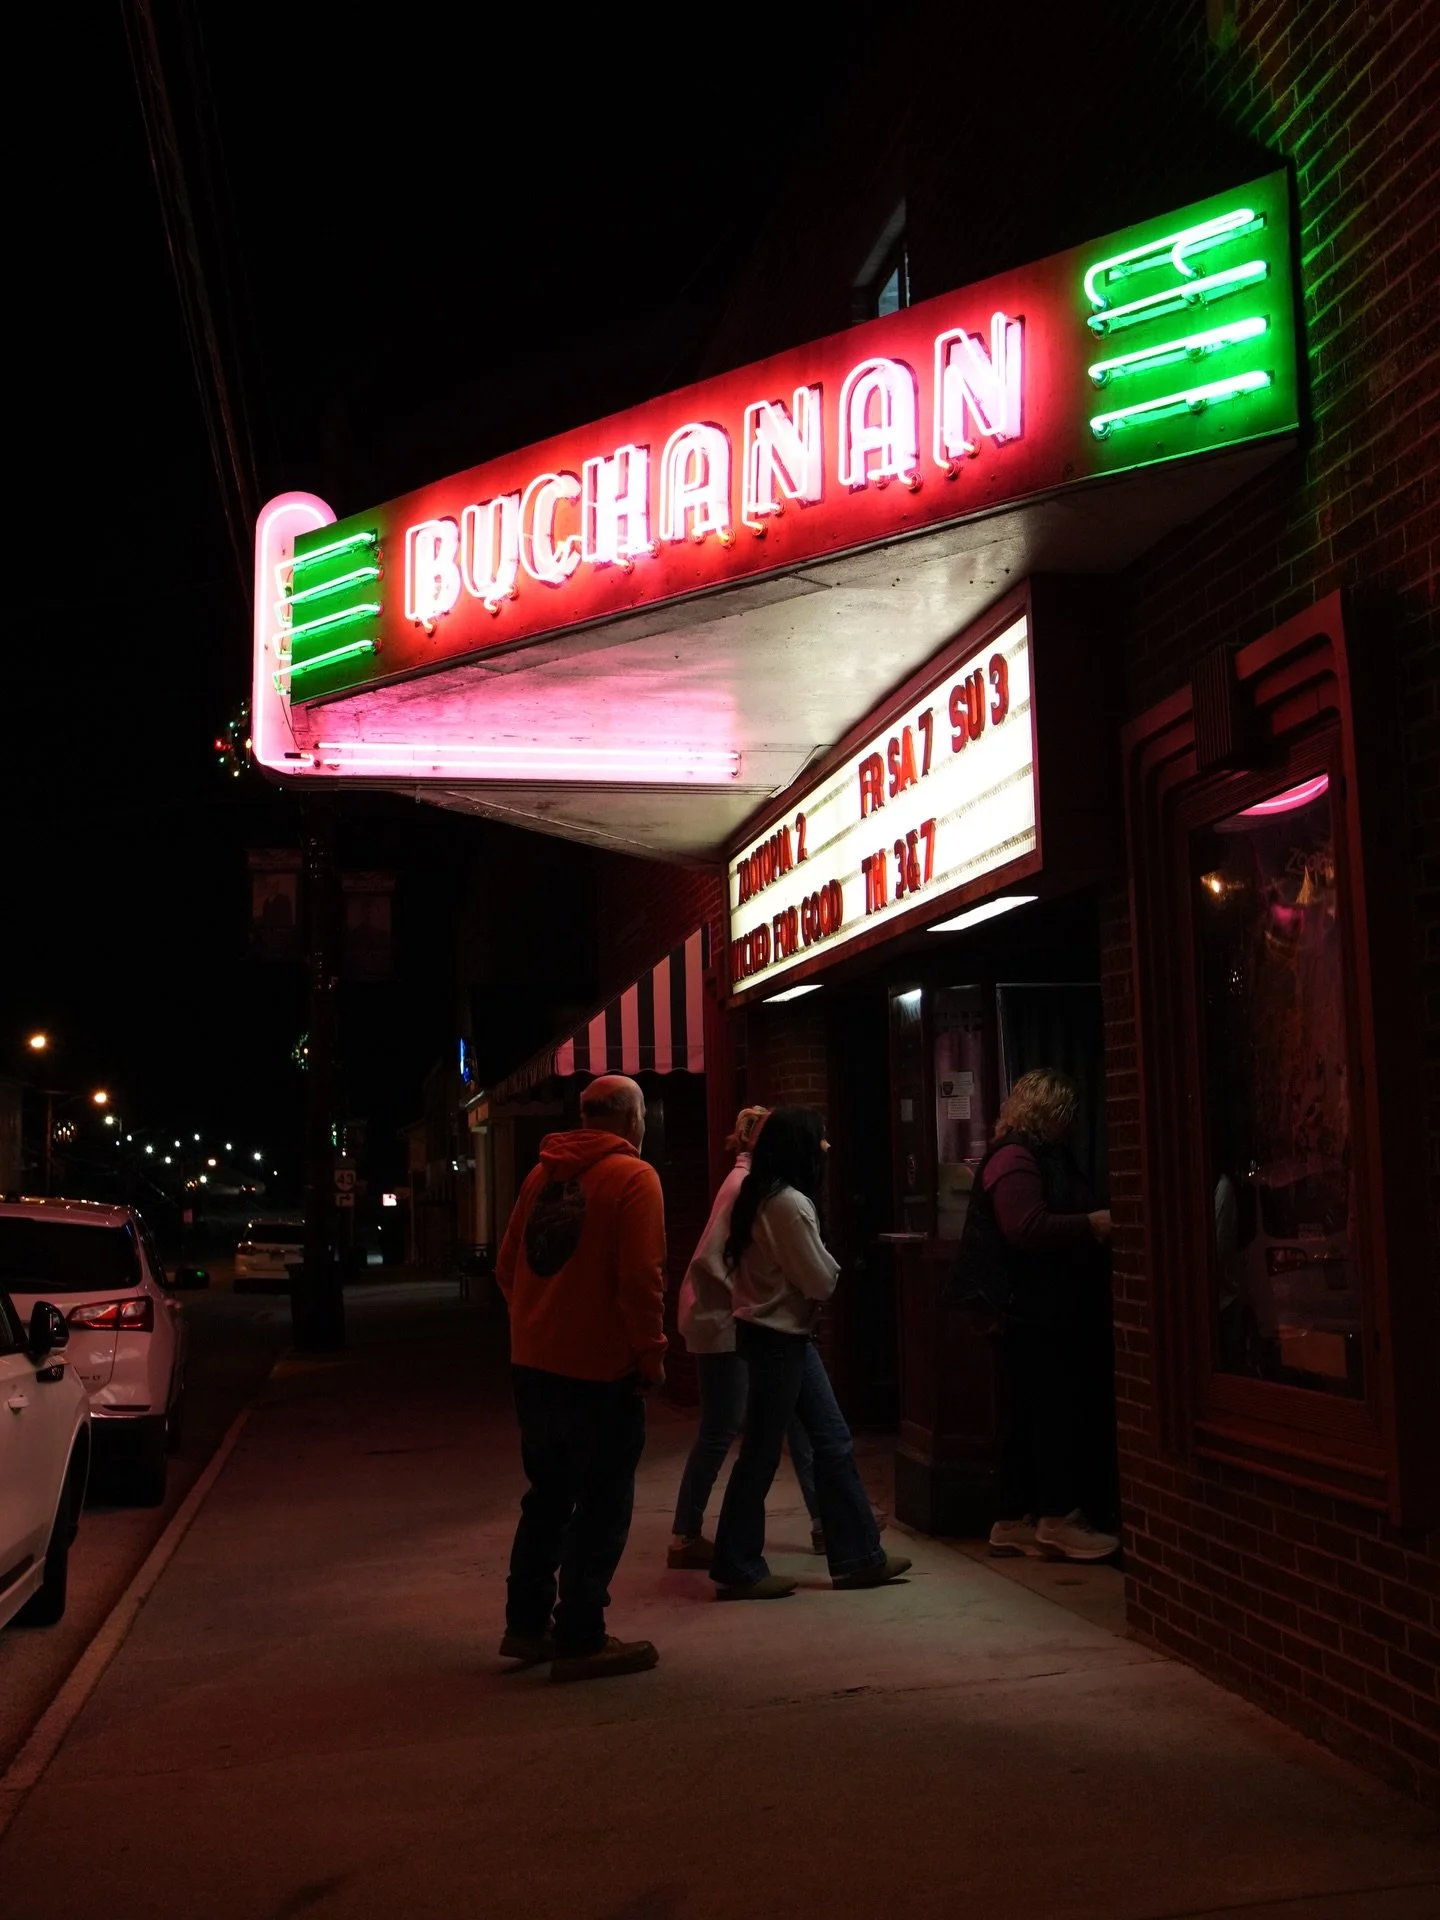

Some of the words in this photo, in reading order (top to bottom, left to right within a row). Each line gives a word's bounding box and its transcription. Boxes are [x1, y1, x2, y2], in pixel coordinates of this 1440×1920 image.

[404, 311, 1025, 624] BUCHANAN
[736, 824, 794, 906] ZOOTOPIA
[795, 812, 808, 864] 2
[859, 752, 885, 820] FR
[888, 725, 918, 798] SA
[918, 707, 933, 777] 7
[949, 667, 986, 754] SU
[989, 653, 1010, 726] 3
[773, 905, 799, 962] FOR
[801, 879, 844, 946] GOOD
[861, 848, 888, 915] TH
[337, 1173, 354, 1187] 43
